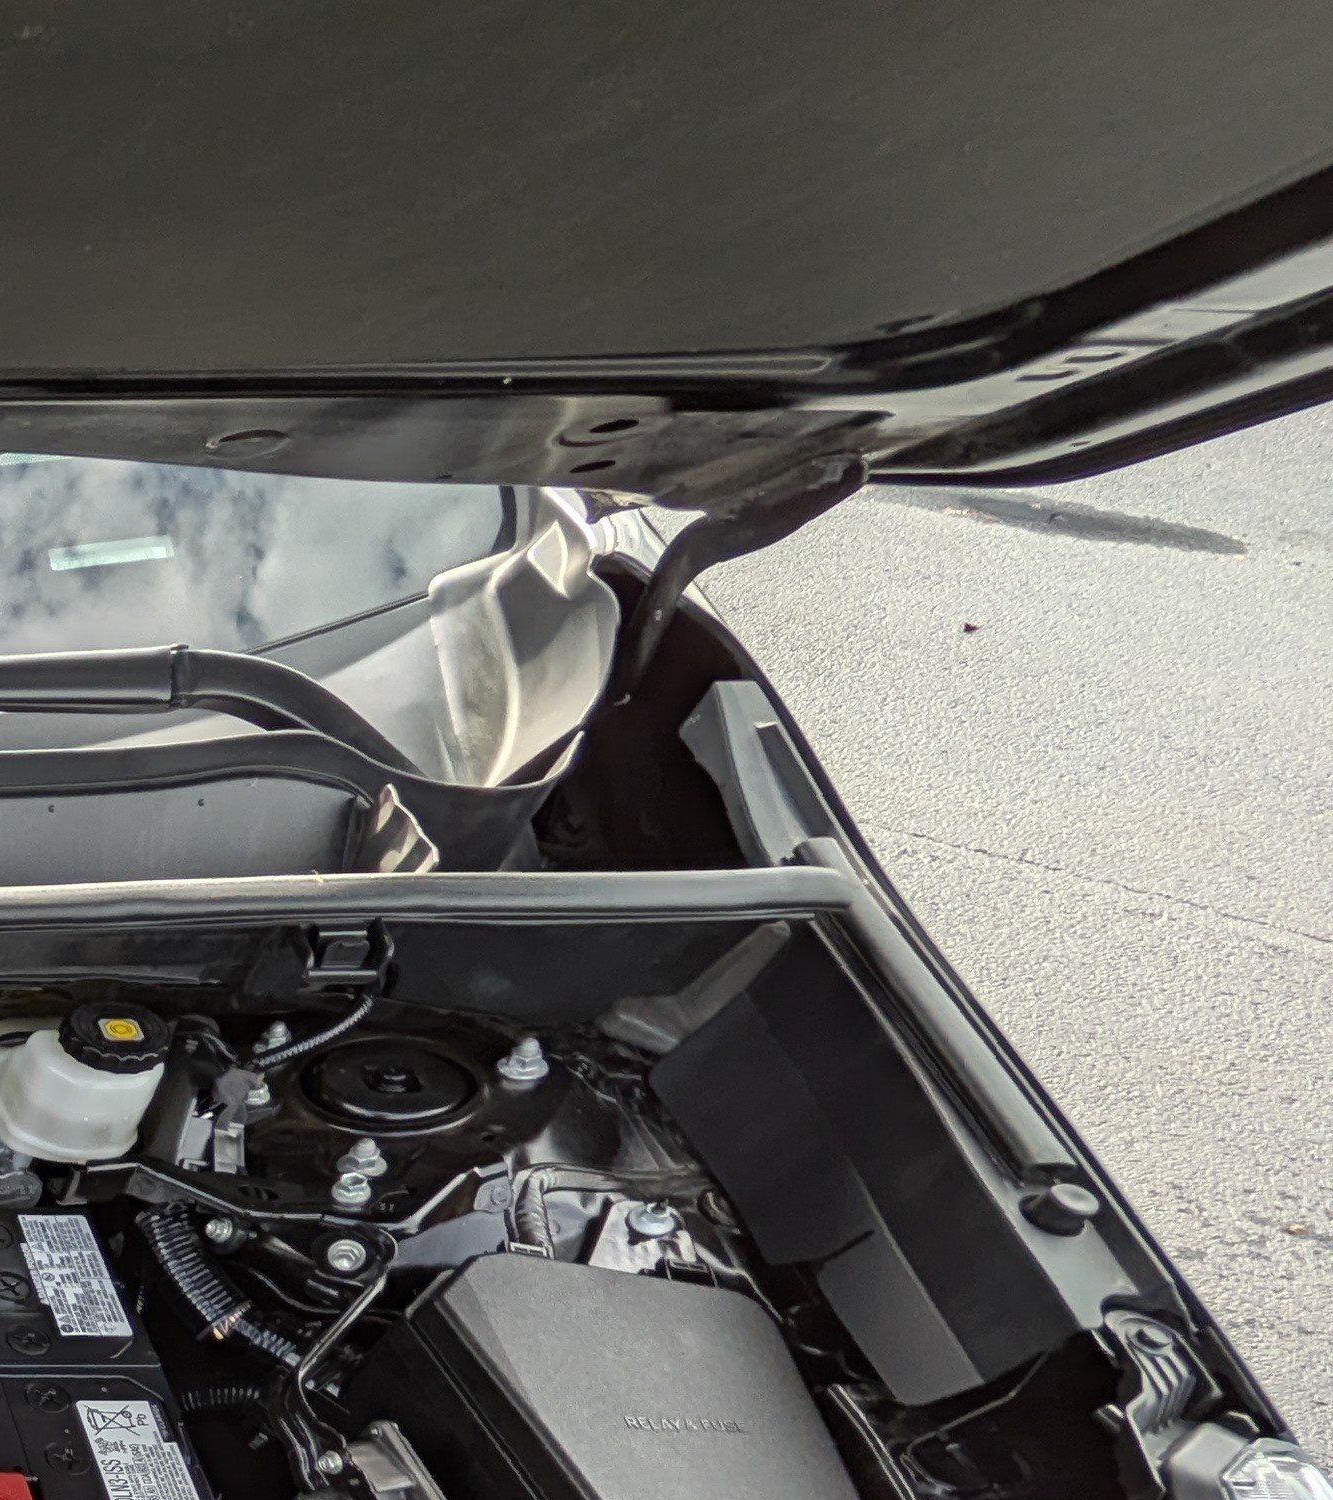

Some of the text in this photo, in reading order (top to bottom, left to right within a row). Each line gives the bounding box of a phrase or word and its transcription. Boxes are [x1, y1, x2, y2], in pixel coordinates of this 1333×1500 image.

[136, 1413, 149, 1427] Pb
[623, 1415, 680, 1433] RELAY
[699, 1418, 749, 1435] FUSE
